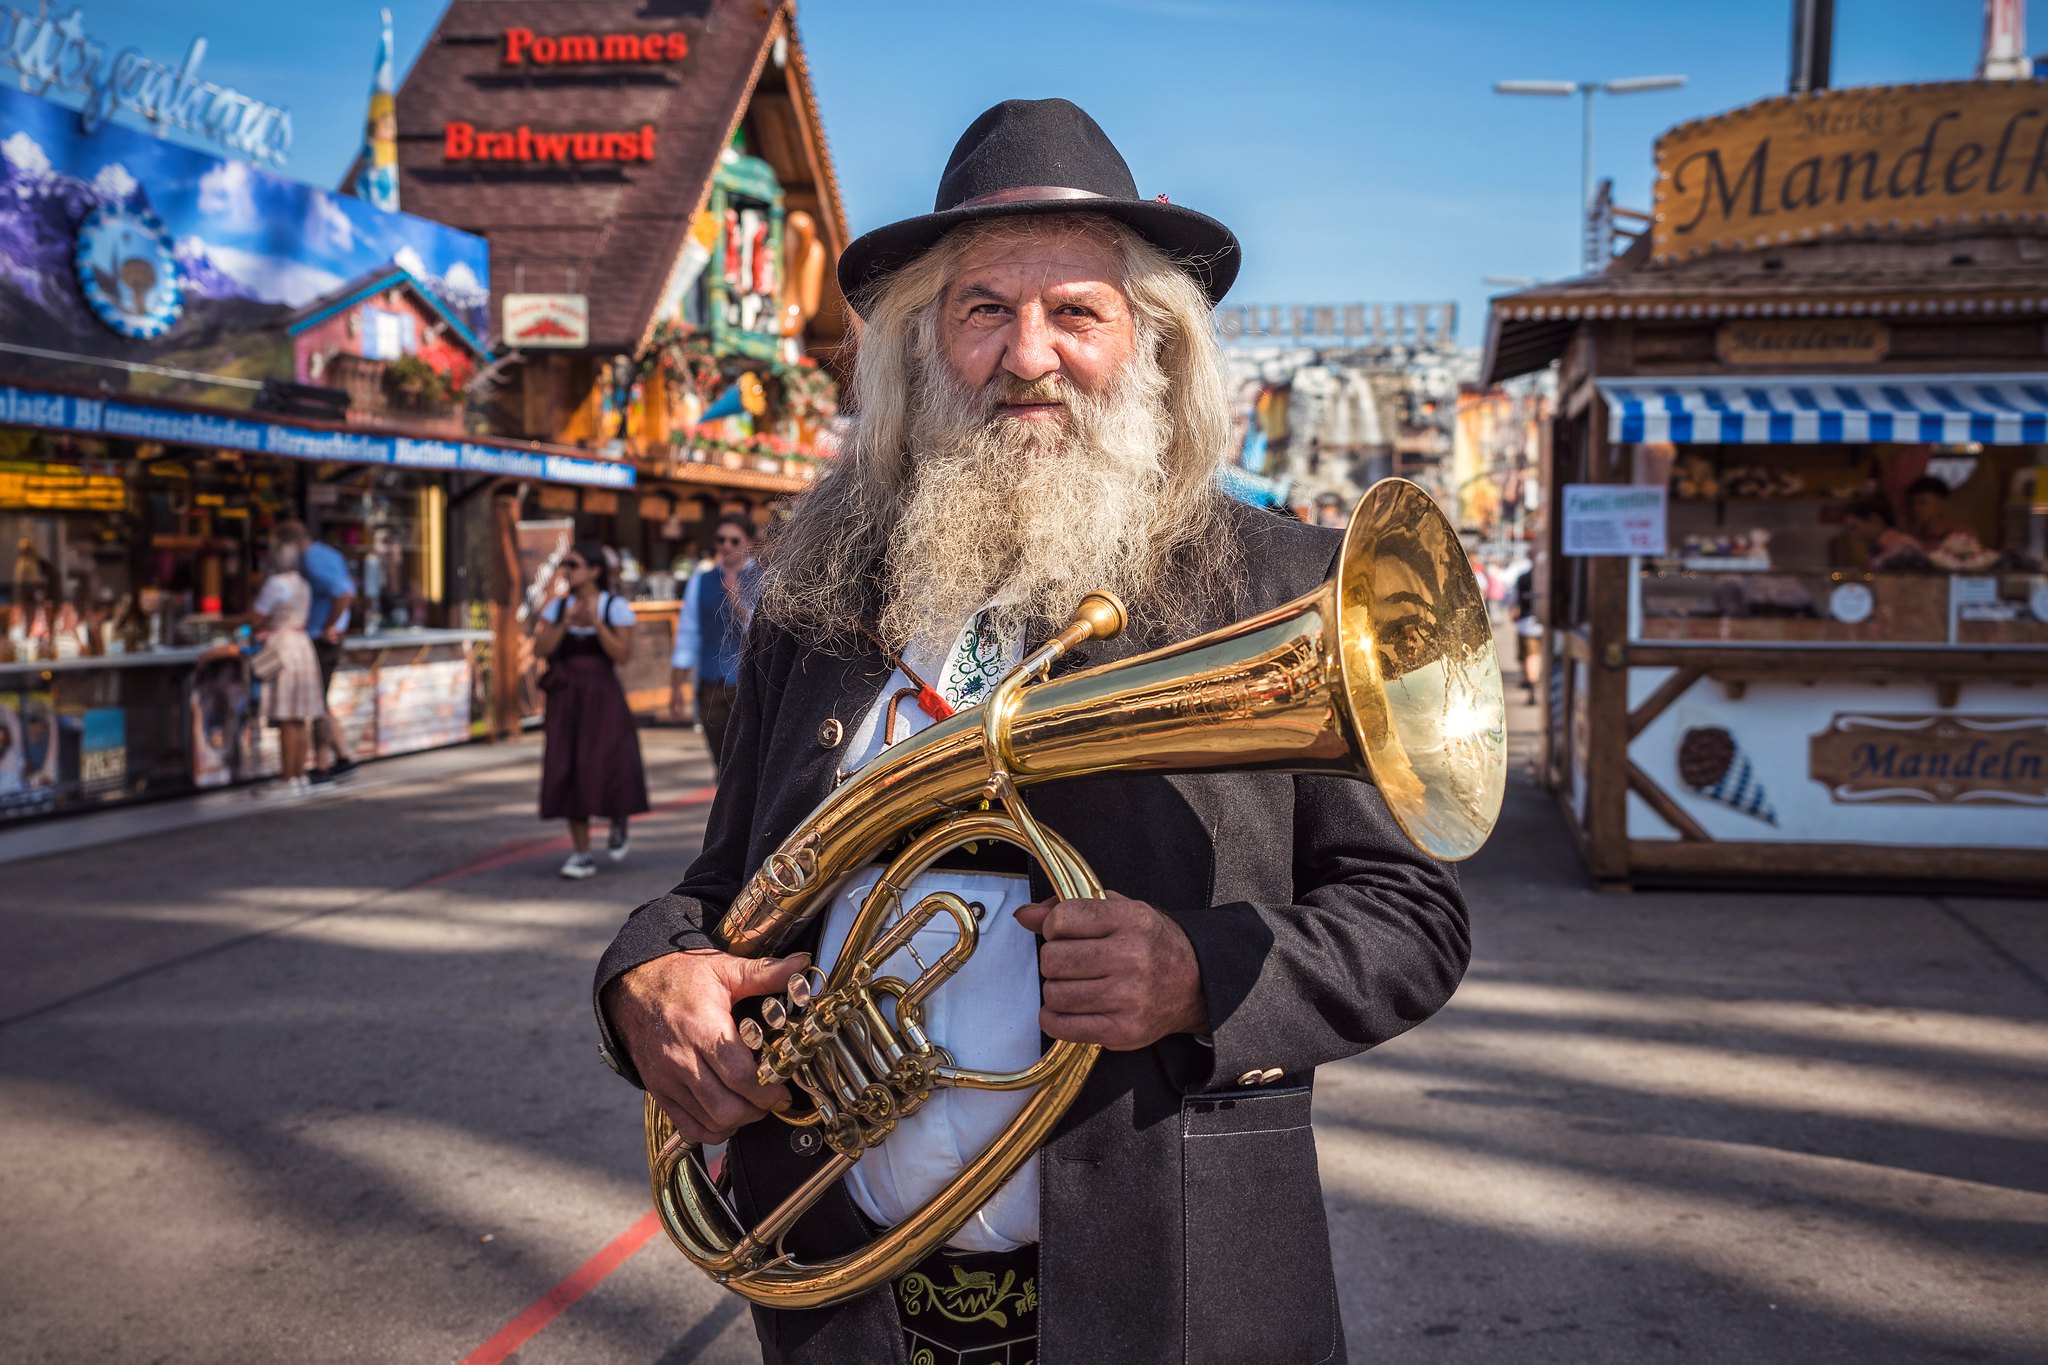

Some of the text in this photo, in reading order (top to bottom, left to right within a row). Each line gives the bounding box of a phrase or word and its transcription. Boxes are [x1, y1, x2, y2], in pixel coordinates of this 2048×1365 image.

[505, 27, 688, 64] Pommes
[444, 121, 655, 161] Bratwurst
[1850, 739, 2044, 781] Mandeln
